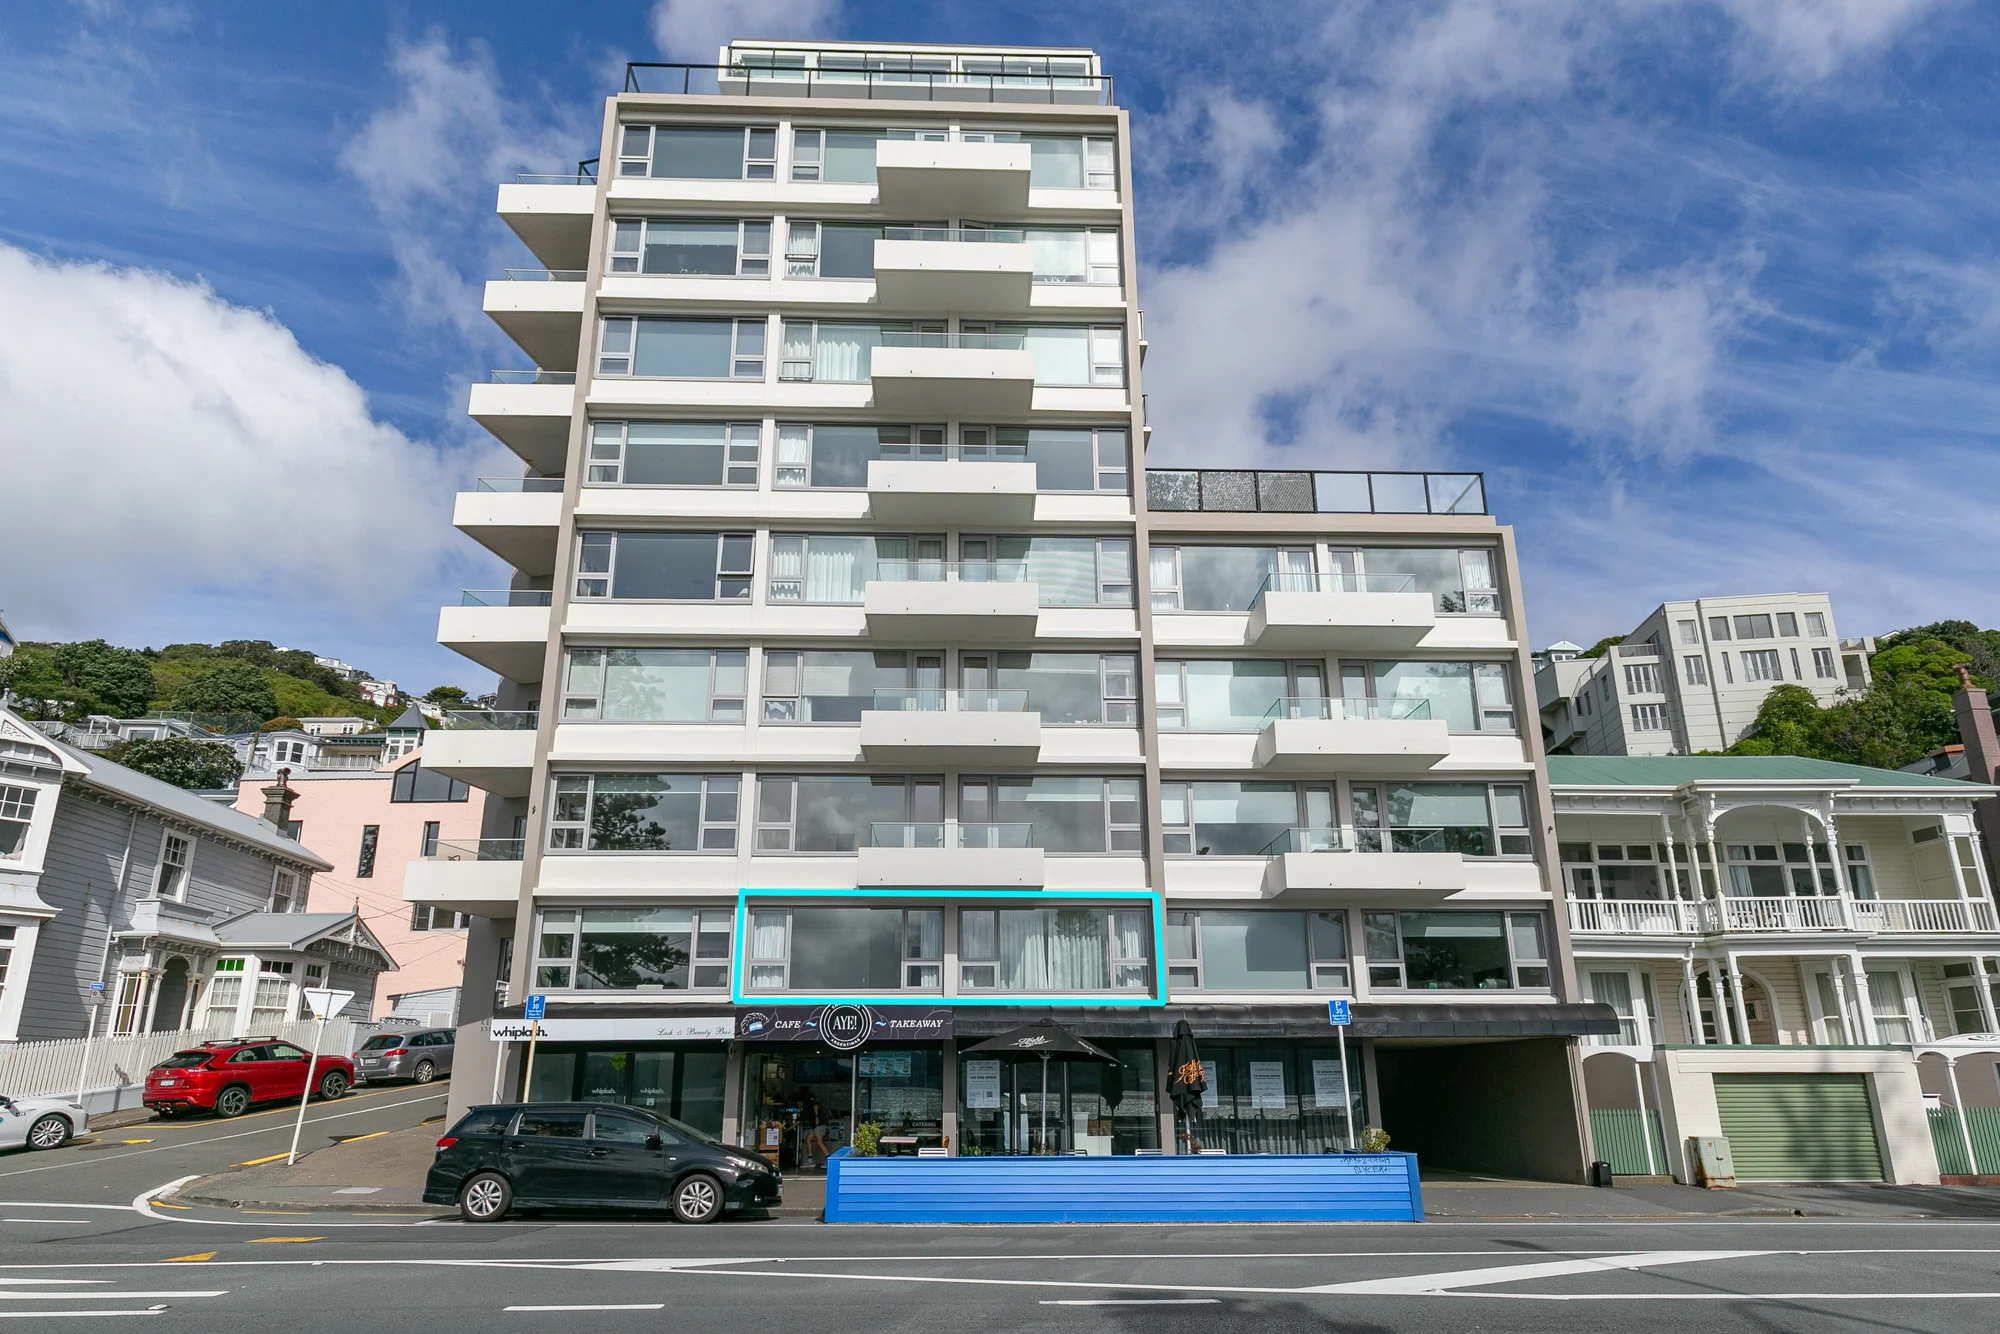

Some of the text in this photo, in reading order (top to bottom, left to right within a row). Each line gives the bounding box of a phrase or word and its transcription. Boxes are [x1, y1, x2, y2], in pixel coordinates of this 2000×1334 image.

[775, 1020, 801, 1029] CAFE
[833, 1016, 857, 1030] AYE!
[890, 1020, 944, 1028] TAKEAWAY
[657, 1028, 674, 1036] Lash
[686, 1027, 711, 1037] Beauty
[715, 1027, 731, 1035] Bar
[831, 1038, 861, 1047] ARGENTINAS
